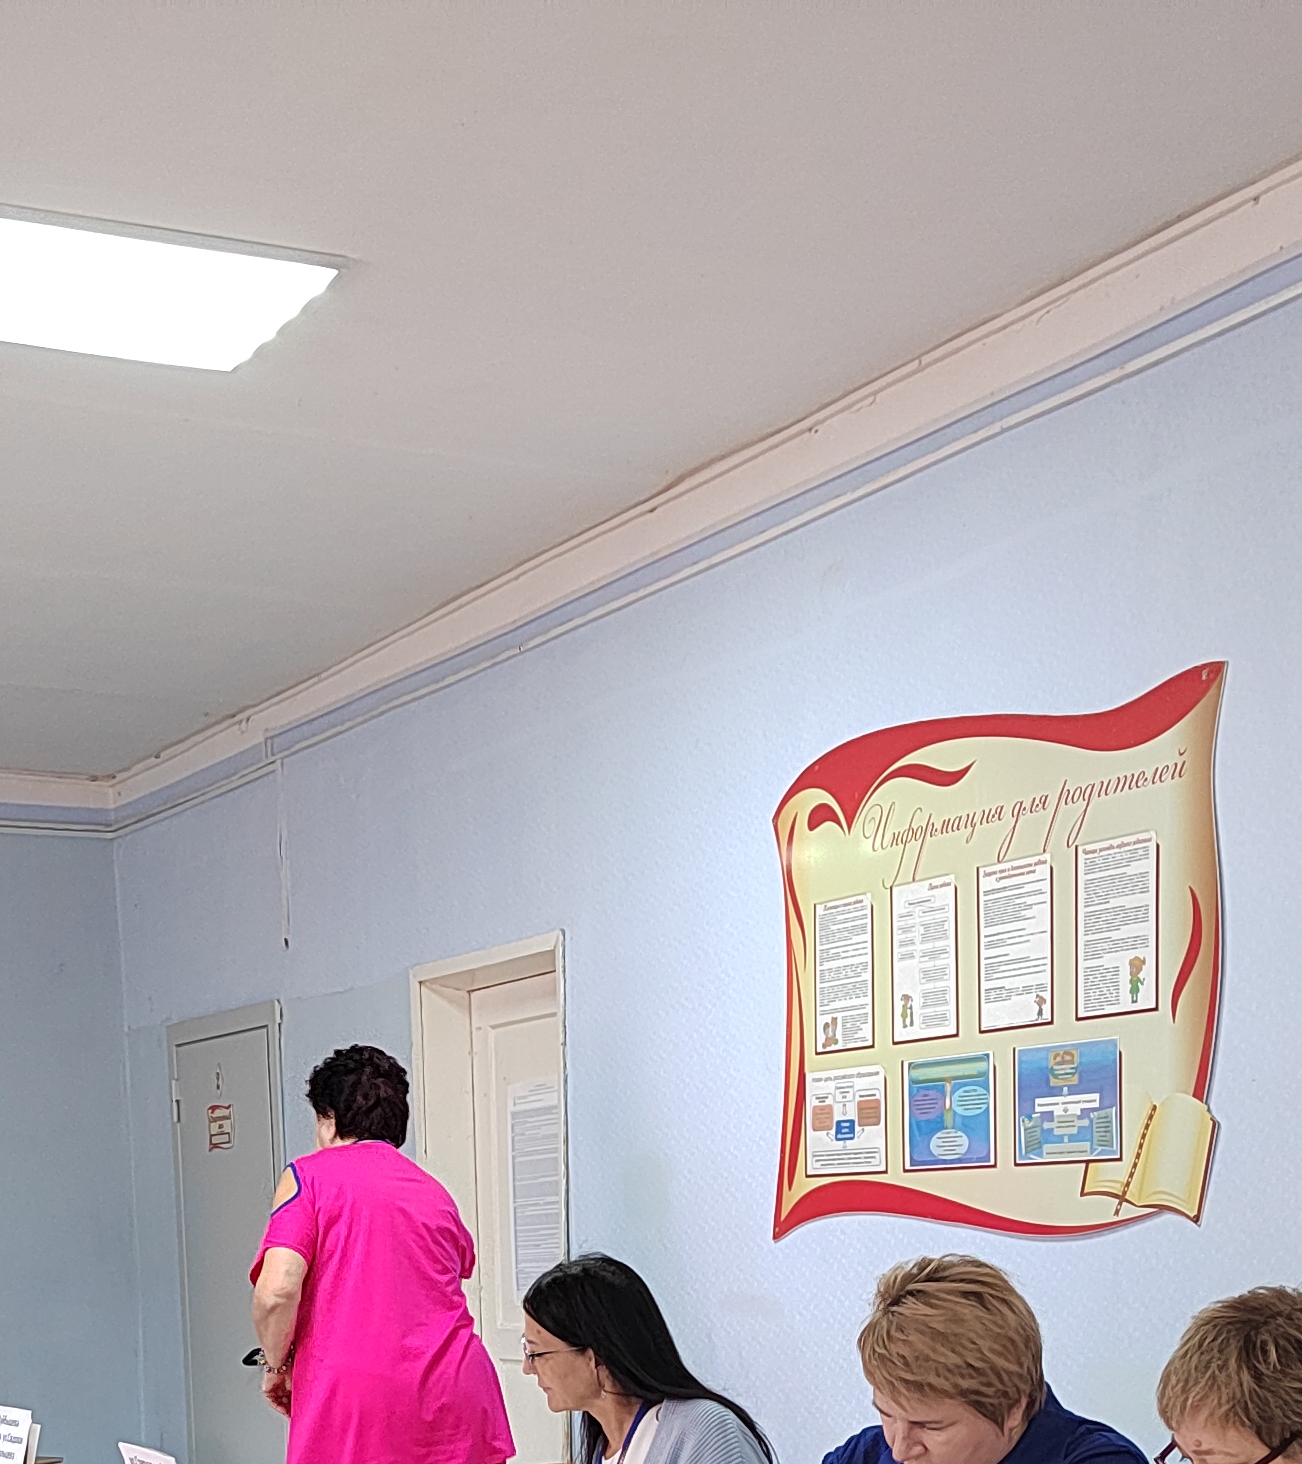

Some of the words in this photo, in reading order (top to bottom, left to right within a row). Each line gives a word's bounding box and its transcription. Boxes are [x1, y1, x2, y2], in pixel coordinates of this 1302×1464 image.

[863, 801, 1004, 889] Информация
[997, 793, 1049, 863] для
[1043, 747, 1188, 853] родителей
